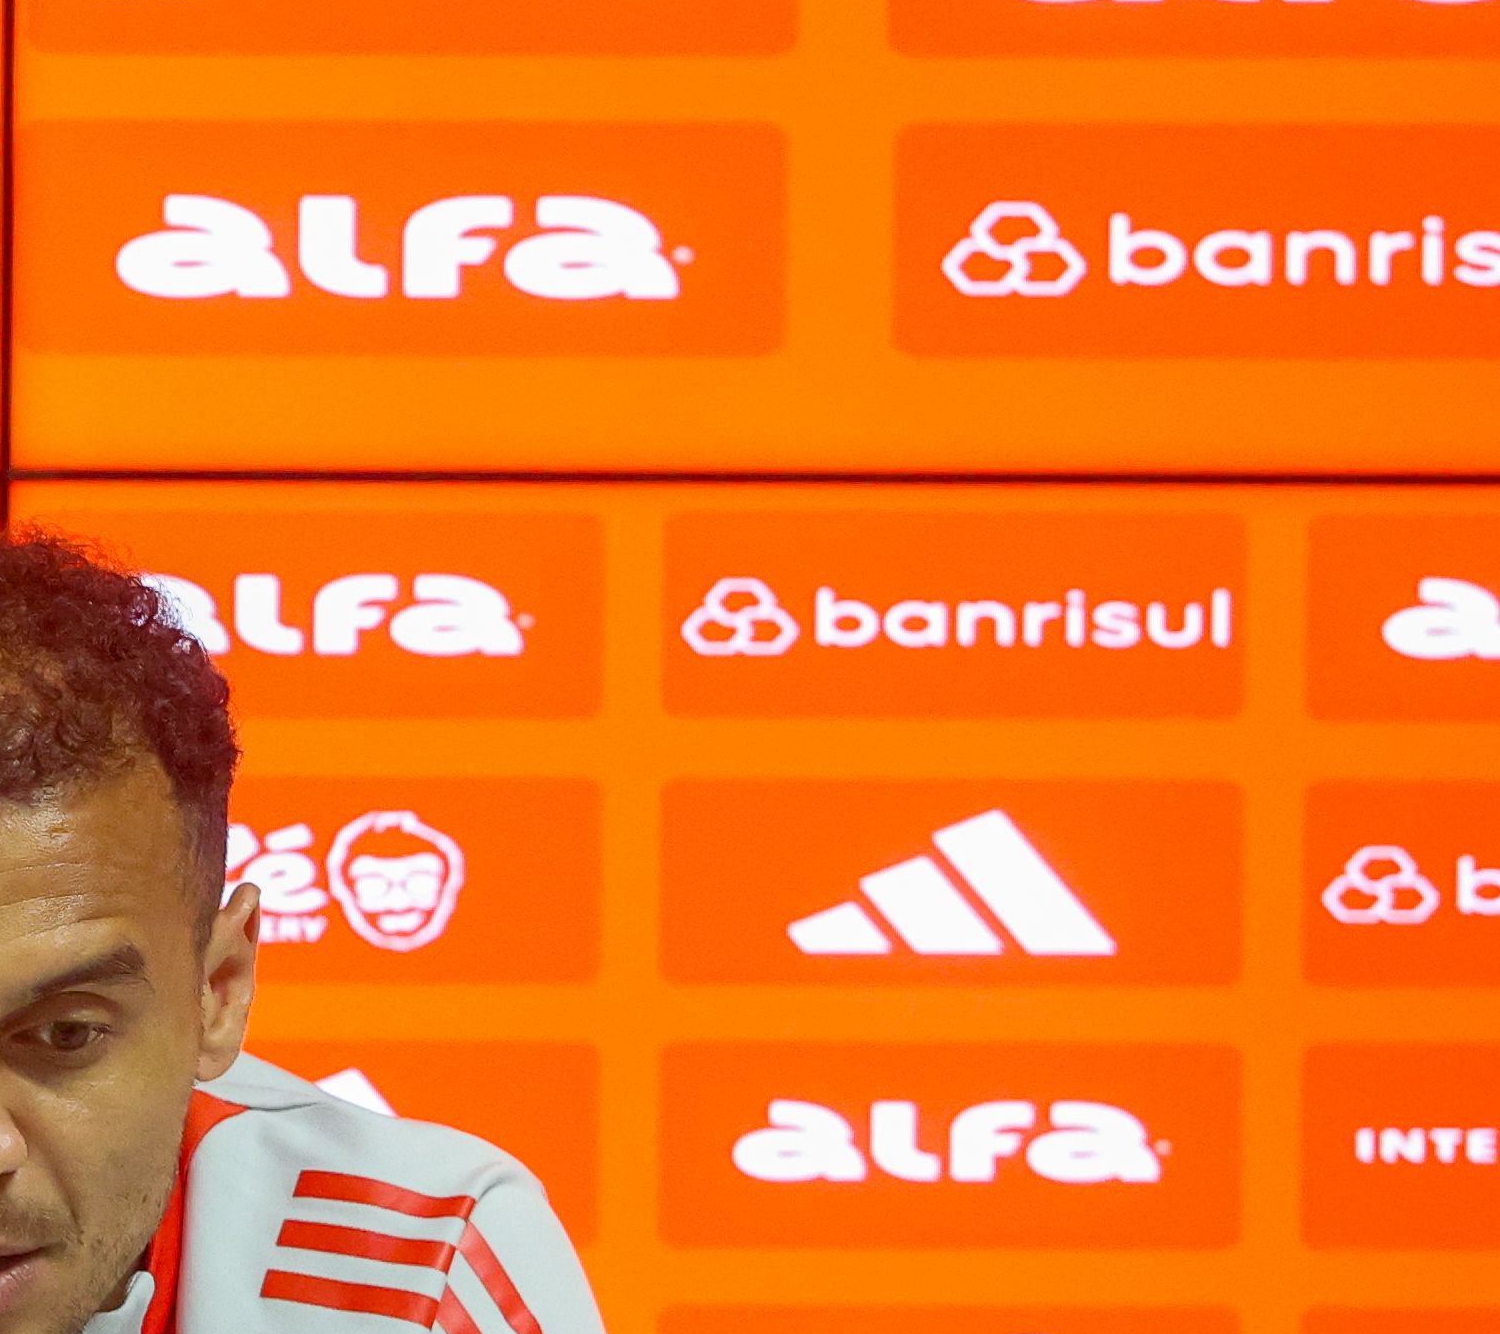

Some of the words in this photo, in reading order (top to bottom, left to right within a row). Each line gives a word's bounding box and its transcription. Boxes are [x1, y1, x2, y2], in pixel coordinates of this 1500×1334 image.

[116, 194, 692, 300] alfa
[1110, 213, 1500, 286] banris
[816, 587, 1231, 648] banrisul
[732, 1100, 1168, 1183] alfa
